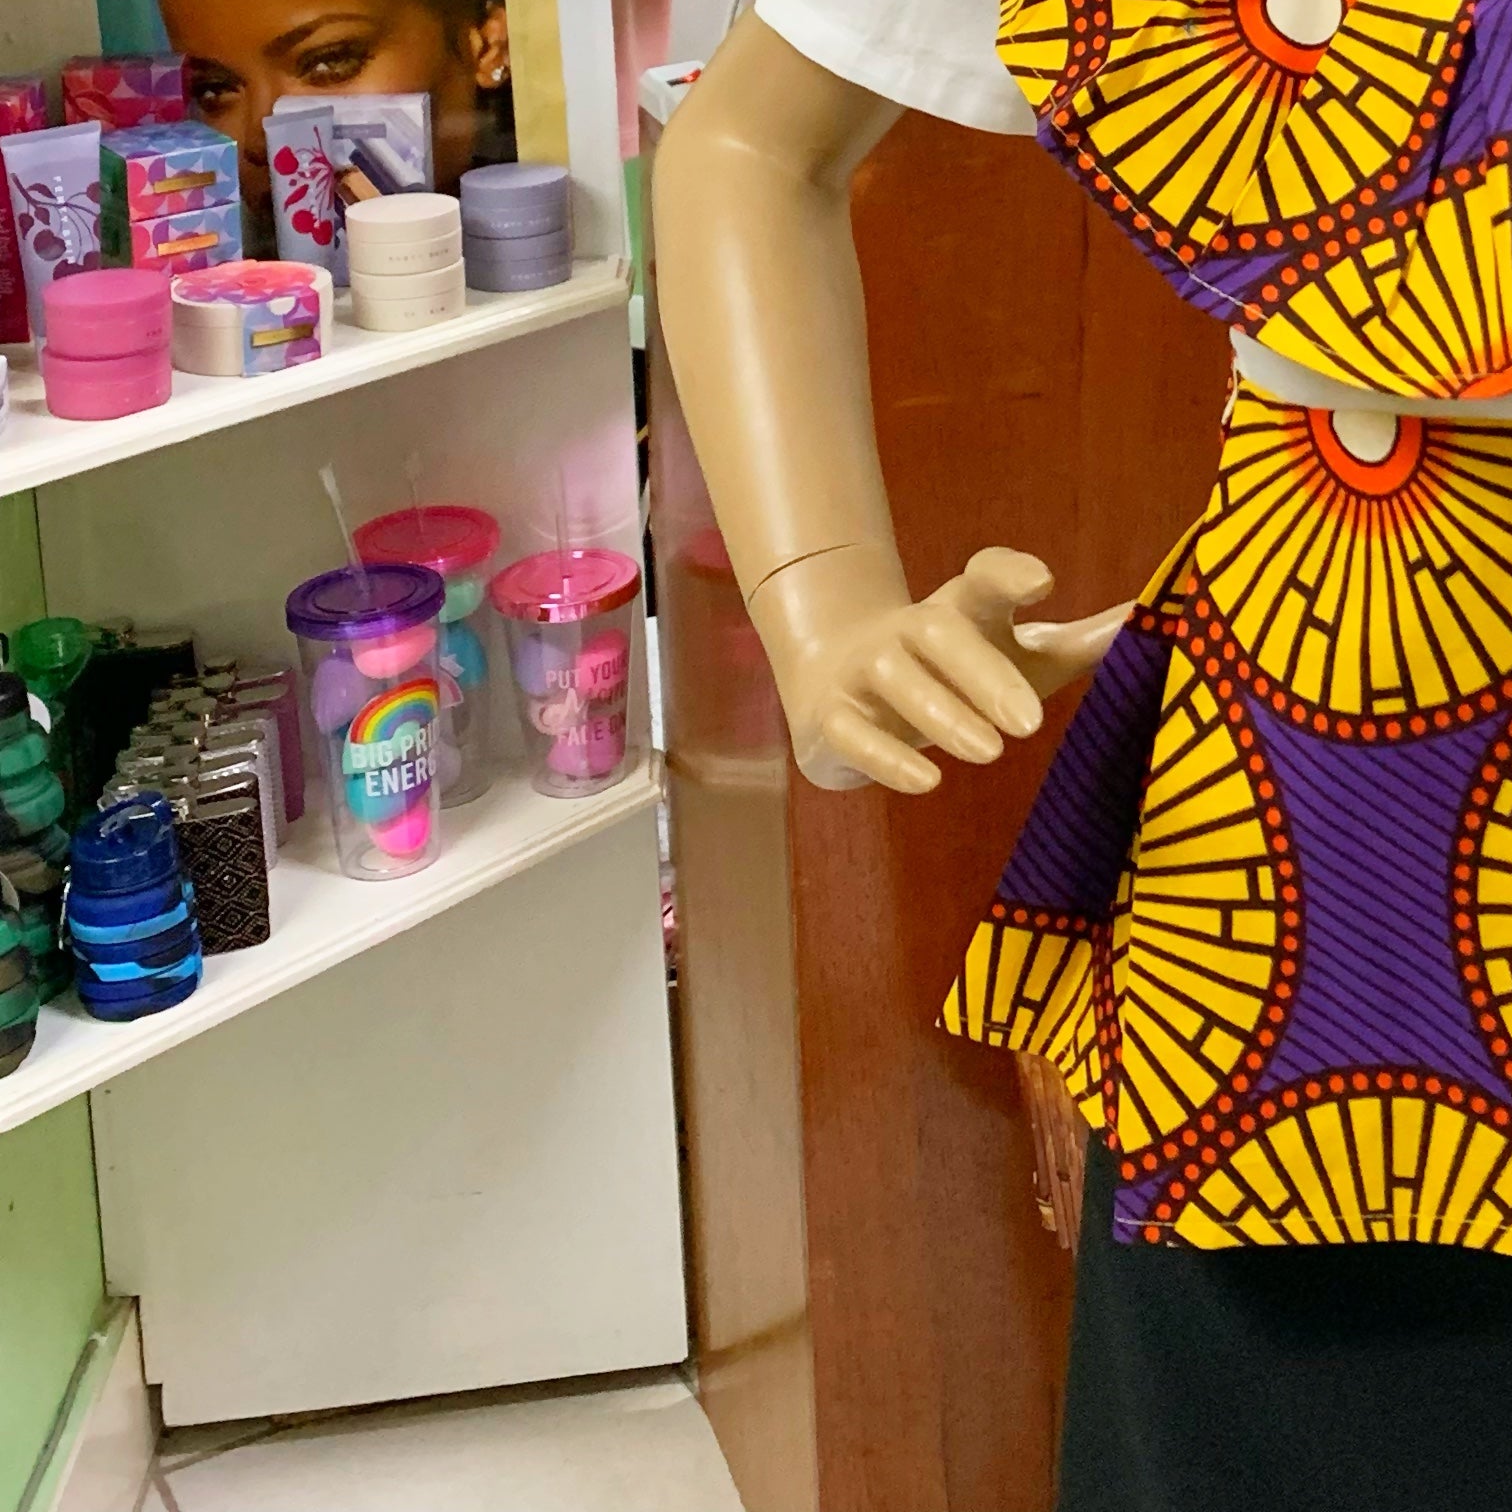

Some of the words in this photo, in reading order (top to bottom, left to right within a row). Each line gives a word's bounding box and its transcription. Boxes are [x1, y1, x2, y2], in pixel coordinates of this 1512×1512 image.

[545, 669, 581, 688] PUT
[350, 740, 393, 769] BIG
[400, 717, 439, 762] PRI
[365, 755, 436, 797] ENERG
